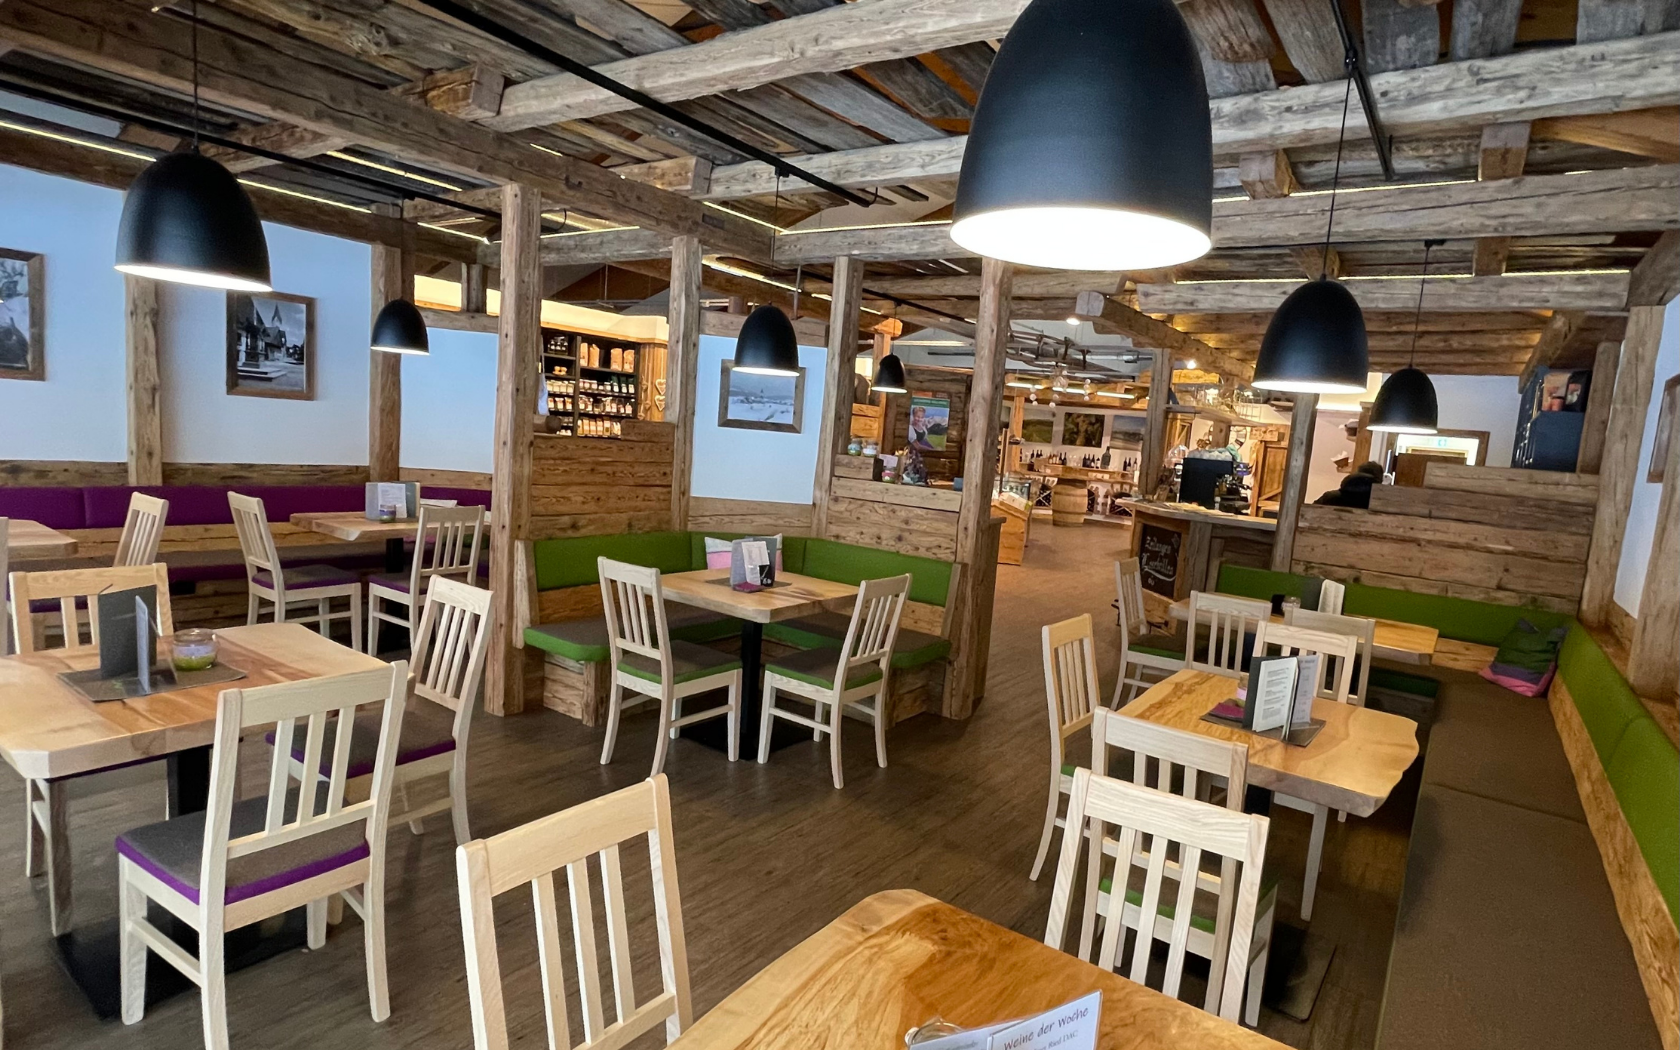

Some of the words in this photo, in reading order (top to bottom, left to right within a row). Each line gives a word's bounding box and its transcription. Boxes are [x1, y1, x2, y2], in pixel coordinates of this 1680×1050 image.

[1003, 1030, 1034, 1050] Weine
[1037, 1023, 1055, 1038] der
[1058, 1007, 1089, 1028] Woche
[1063, 1030, 1079, 1044] DAC
